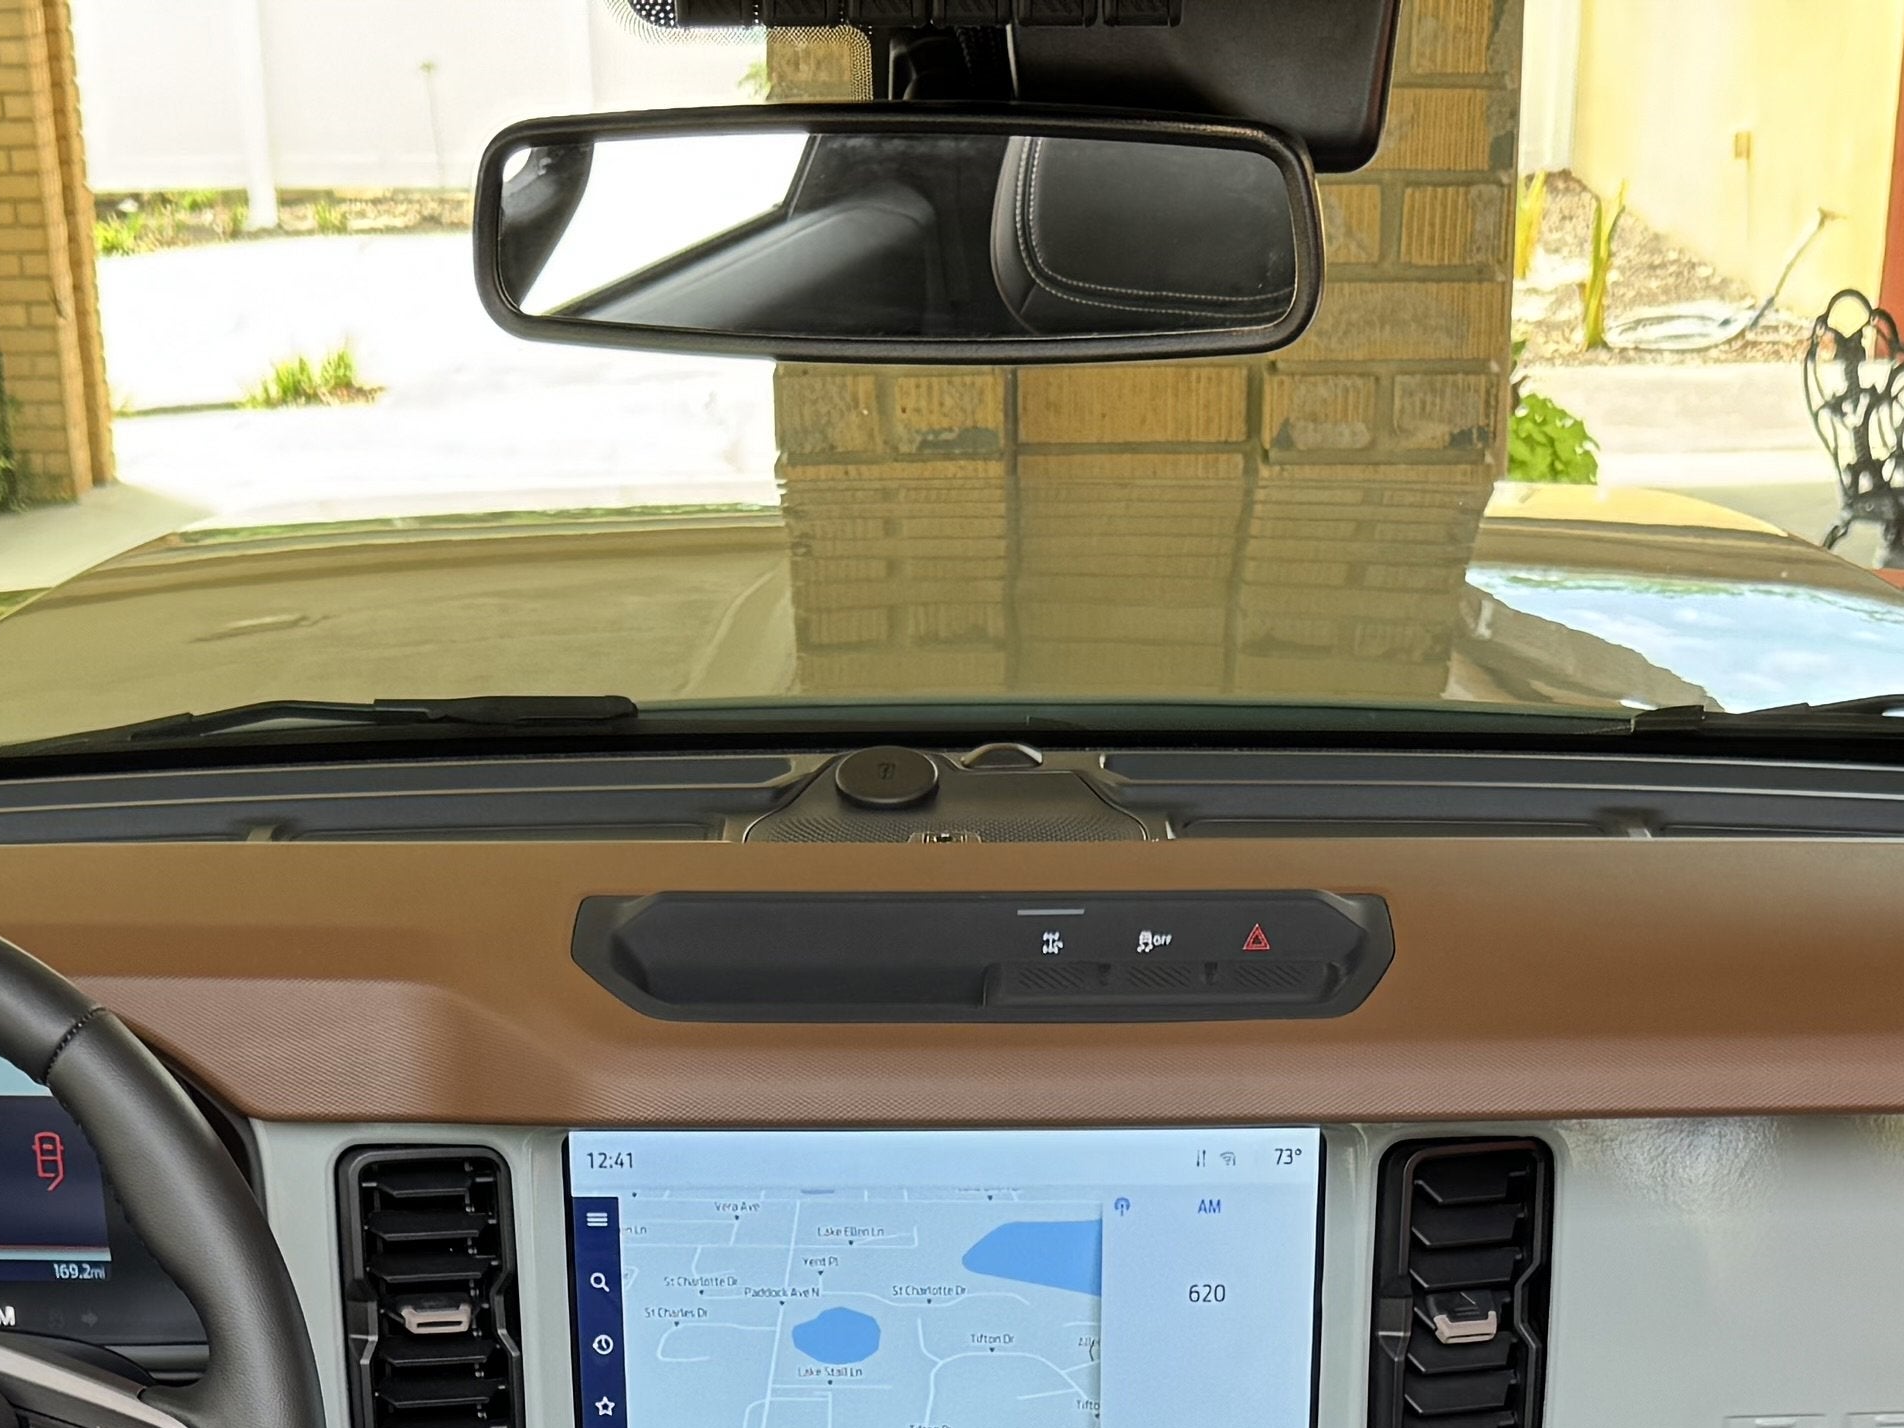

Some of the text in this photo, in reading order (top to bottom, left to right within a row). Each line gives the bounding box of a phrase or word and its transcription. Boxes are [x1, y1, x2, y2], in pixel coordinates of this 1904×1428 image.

[586, 1151, 634, 1170] 12:41
[1274, 1147, 1303, 1166] 73°
[714, 1201, 761, 1212] Vera Ave
[1197, 1199, 1222, 1214] AM
[818, 1226, 840, 1238] Lake
[870, 1226, 884, 1238] Ln
[664, 1276, 675, 1287] St
[790, 1287, 811, 1299] Ave
[811, 1287, 820, 1299] N
[892, 1284, 967, 1296] St Charlotte Dr
[1188, 1284, 1226, 1303] 620
[645, 1307, 656, 1319] St
[657, 1307, 696, 1319] Charles
[970, 1333, 1015, 1345] Tifton Dr
[798, 1366, 822, 1378] Lake
